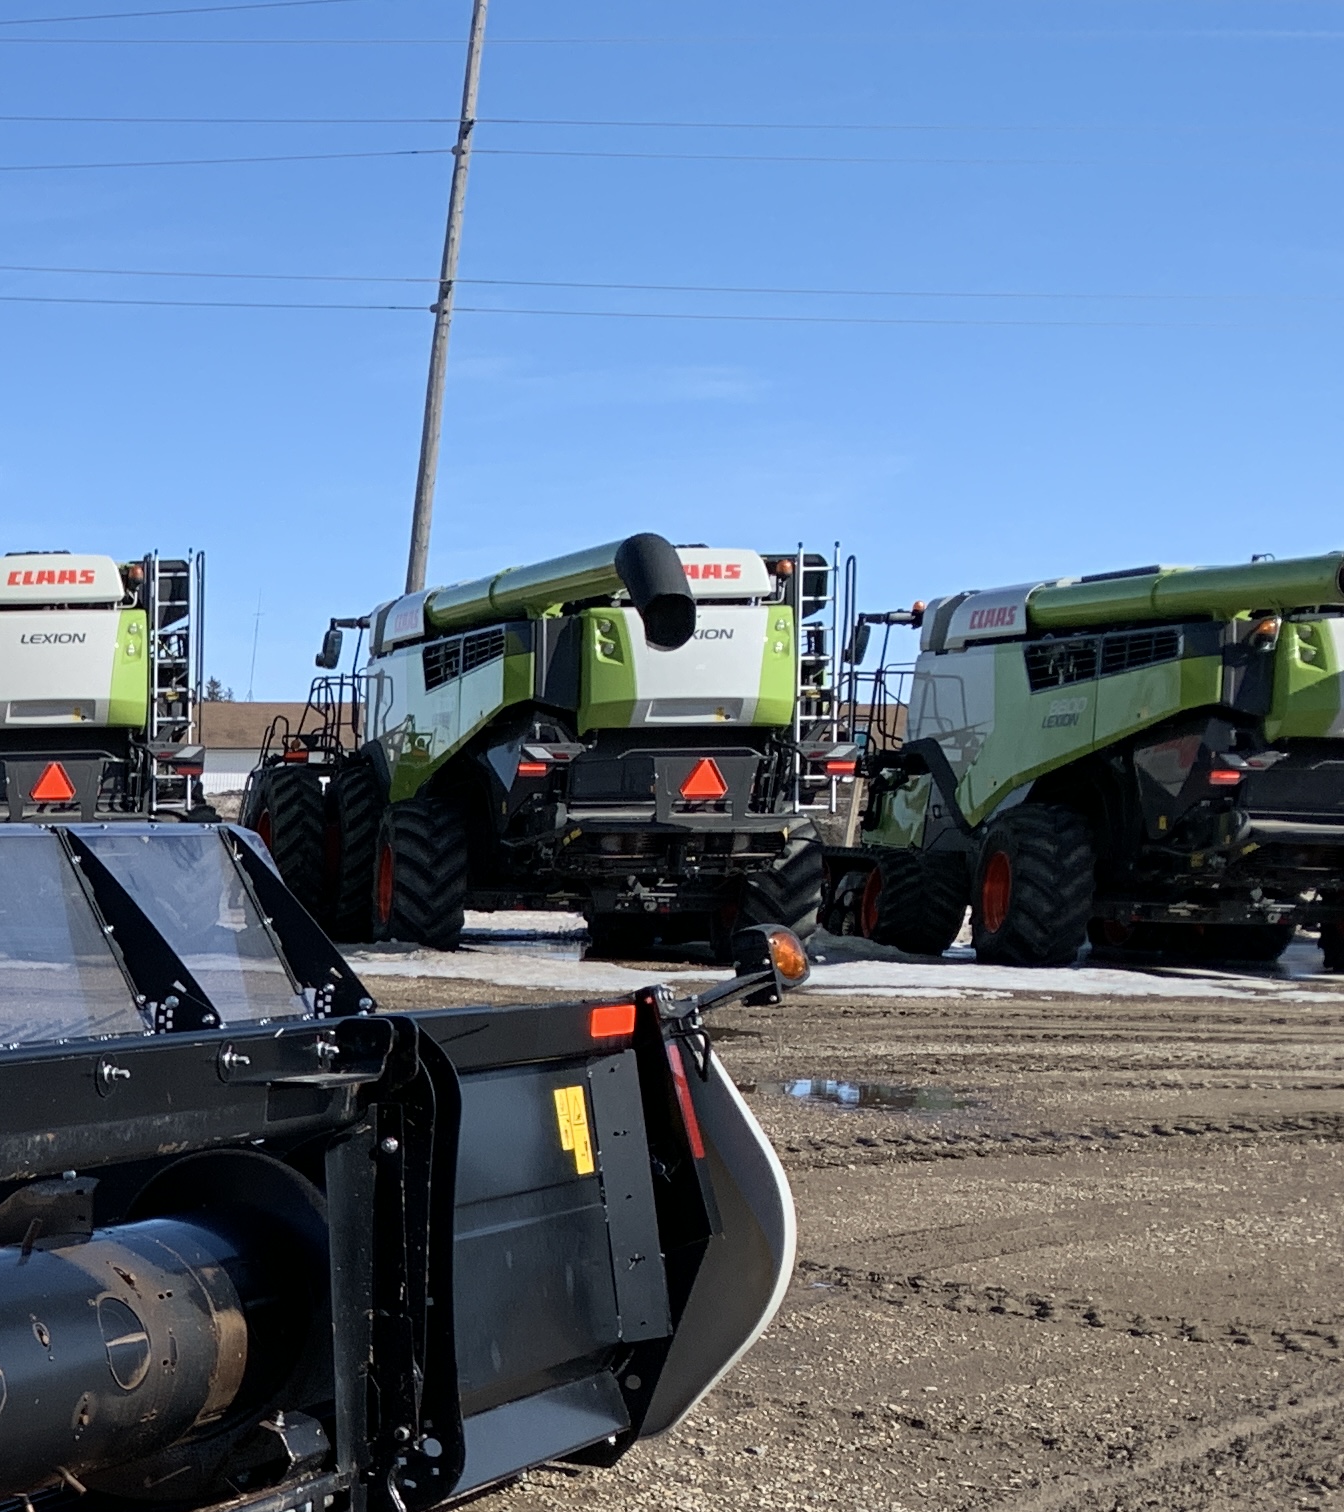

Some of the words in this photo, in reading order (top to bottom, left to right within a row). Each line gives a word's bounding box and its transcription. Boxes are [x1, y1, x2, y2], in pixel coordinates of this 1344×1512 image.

[7, 569, 96, 586] CLAAS
[682, 563, 742, 580] AAS
[969, 605, 1018, 630] CLAAS
[20, 632, 87, 645] LEXION
[692, 628, 734, 640] XION
[1042, 713, 1080, 729] LEXION
